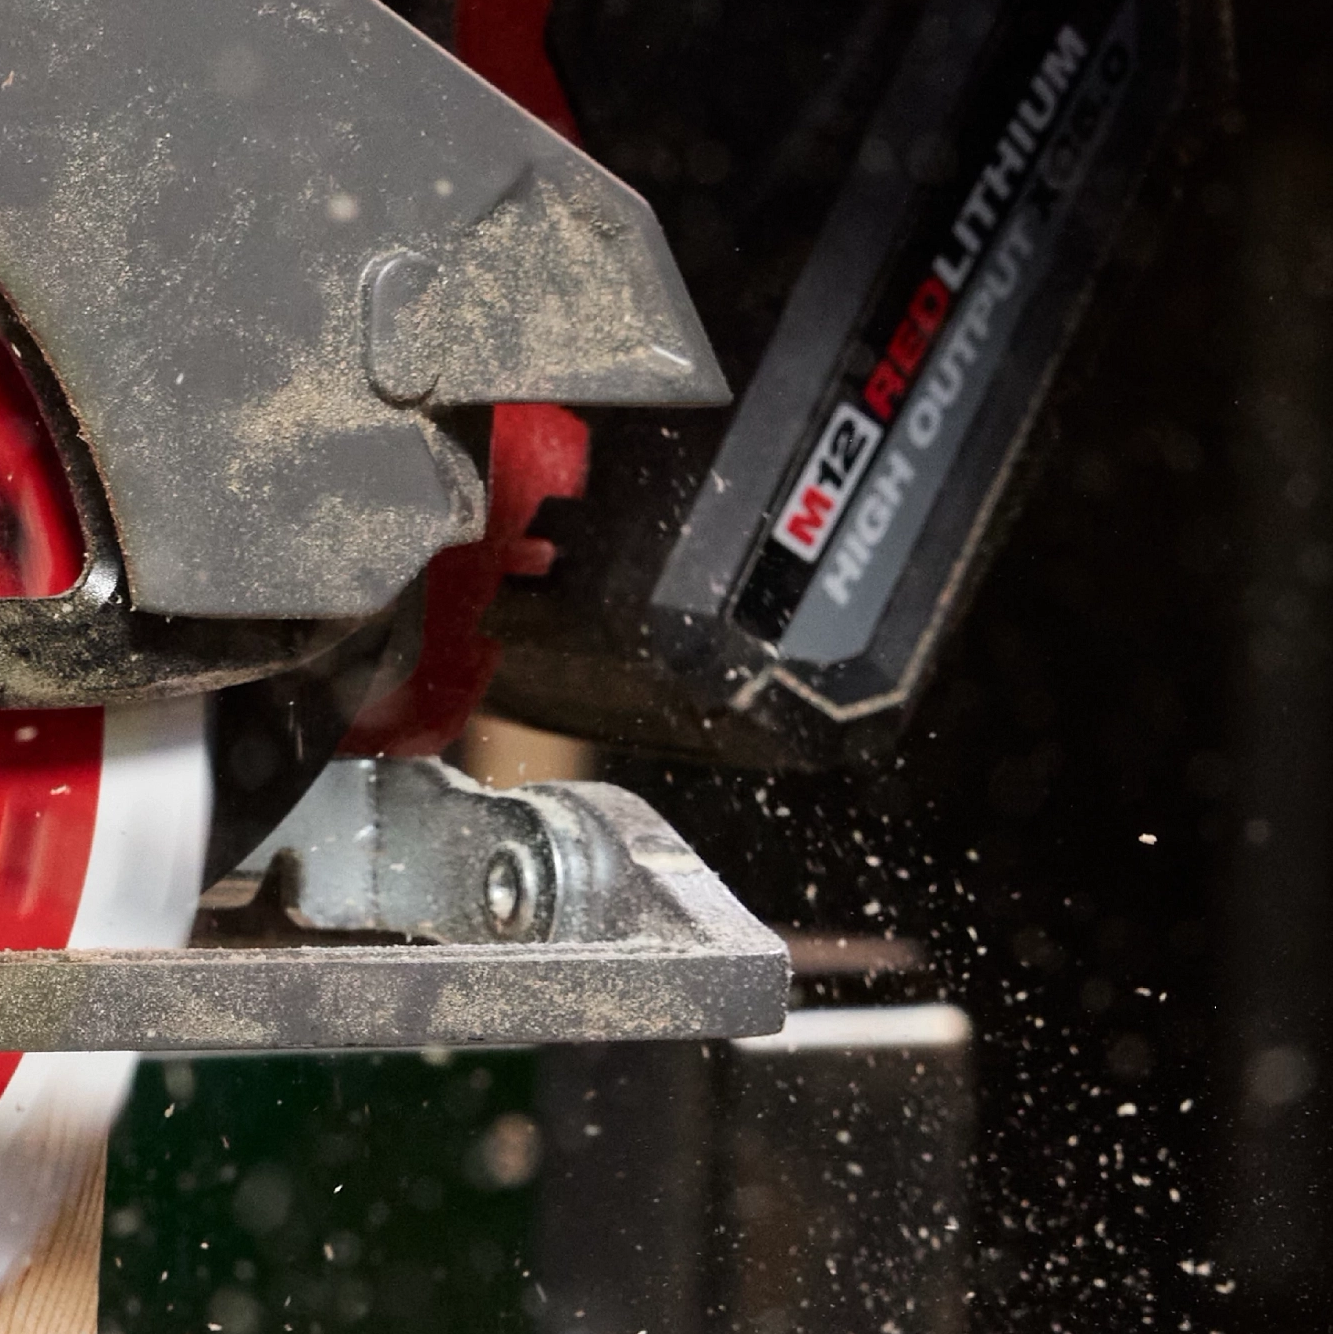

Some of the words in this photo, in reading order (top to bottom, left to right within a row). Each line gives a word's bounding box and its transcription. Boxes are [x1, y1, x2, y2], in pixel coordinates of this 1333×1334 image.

[785, 419, 867, 547] M12
[864, 23, 1088, 422] REDLITHIUM
[821, 450, 915, 605] HIGH
[908, 220, 1032, 449] OUTPUT
